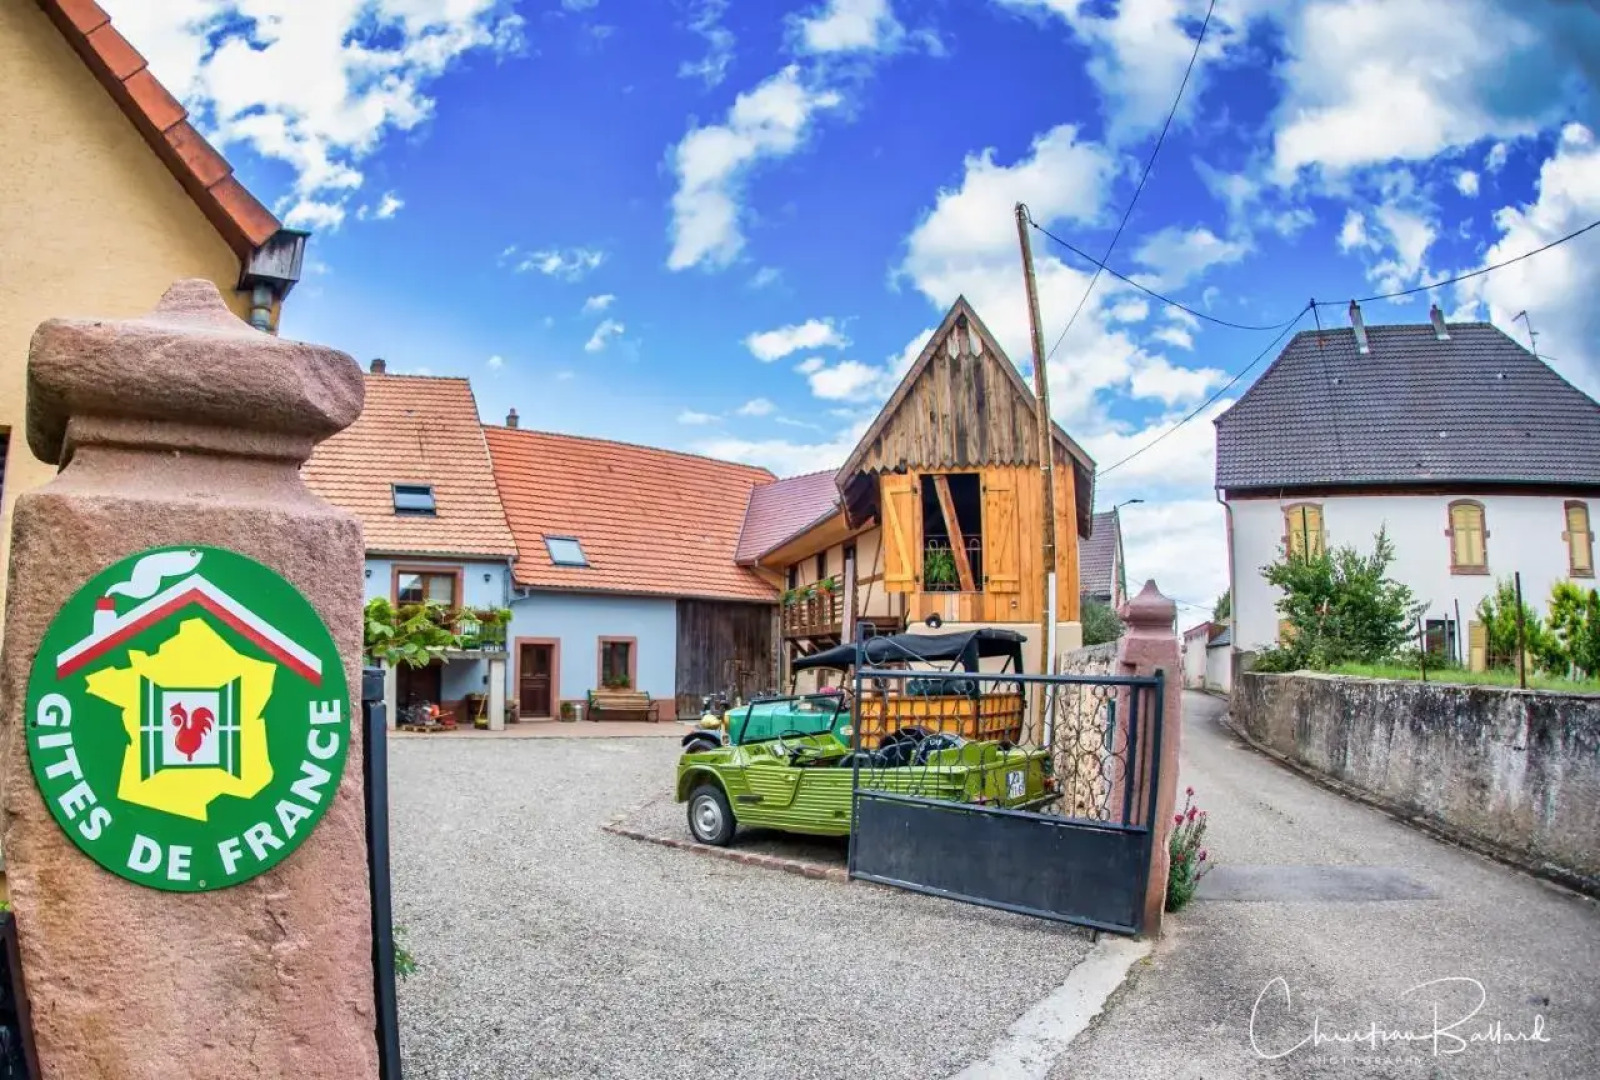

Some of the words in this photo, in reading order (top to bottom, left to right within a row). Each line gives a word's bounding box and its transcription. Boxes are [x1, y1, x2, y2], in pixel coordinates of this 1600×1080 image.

[37, 693, 112, 841] GITES
[127, 834, 192, 881] DE
[217, 699, 341, 875] FRANCE
